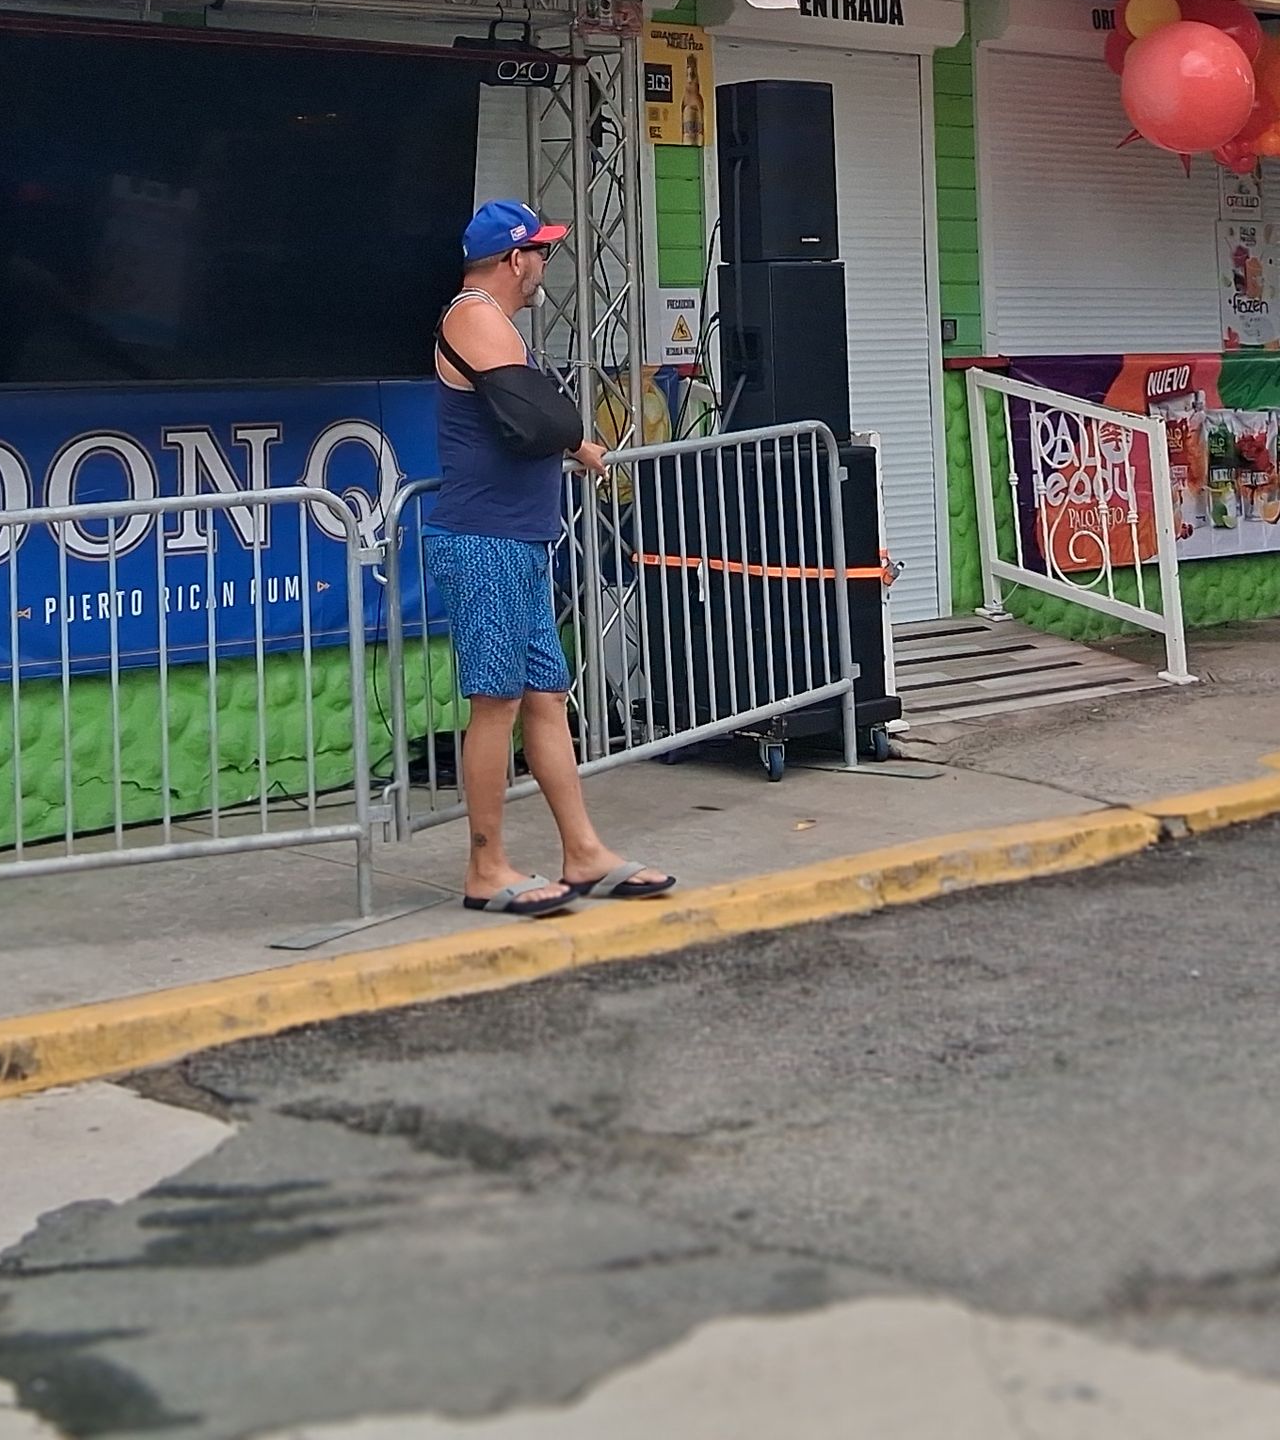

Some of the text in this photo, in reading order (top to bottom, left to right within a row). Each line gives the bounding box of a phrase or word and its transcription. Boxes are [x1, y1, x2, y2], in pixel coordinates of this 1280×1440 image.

[1147, 364, 1191, 397] NUEVO
[296, 418, 408, 551] Q
[1067, 506, 1124, 533] PALO VEJO
[44, 588, 144, 626] PUERTO
